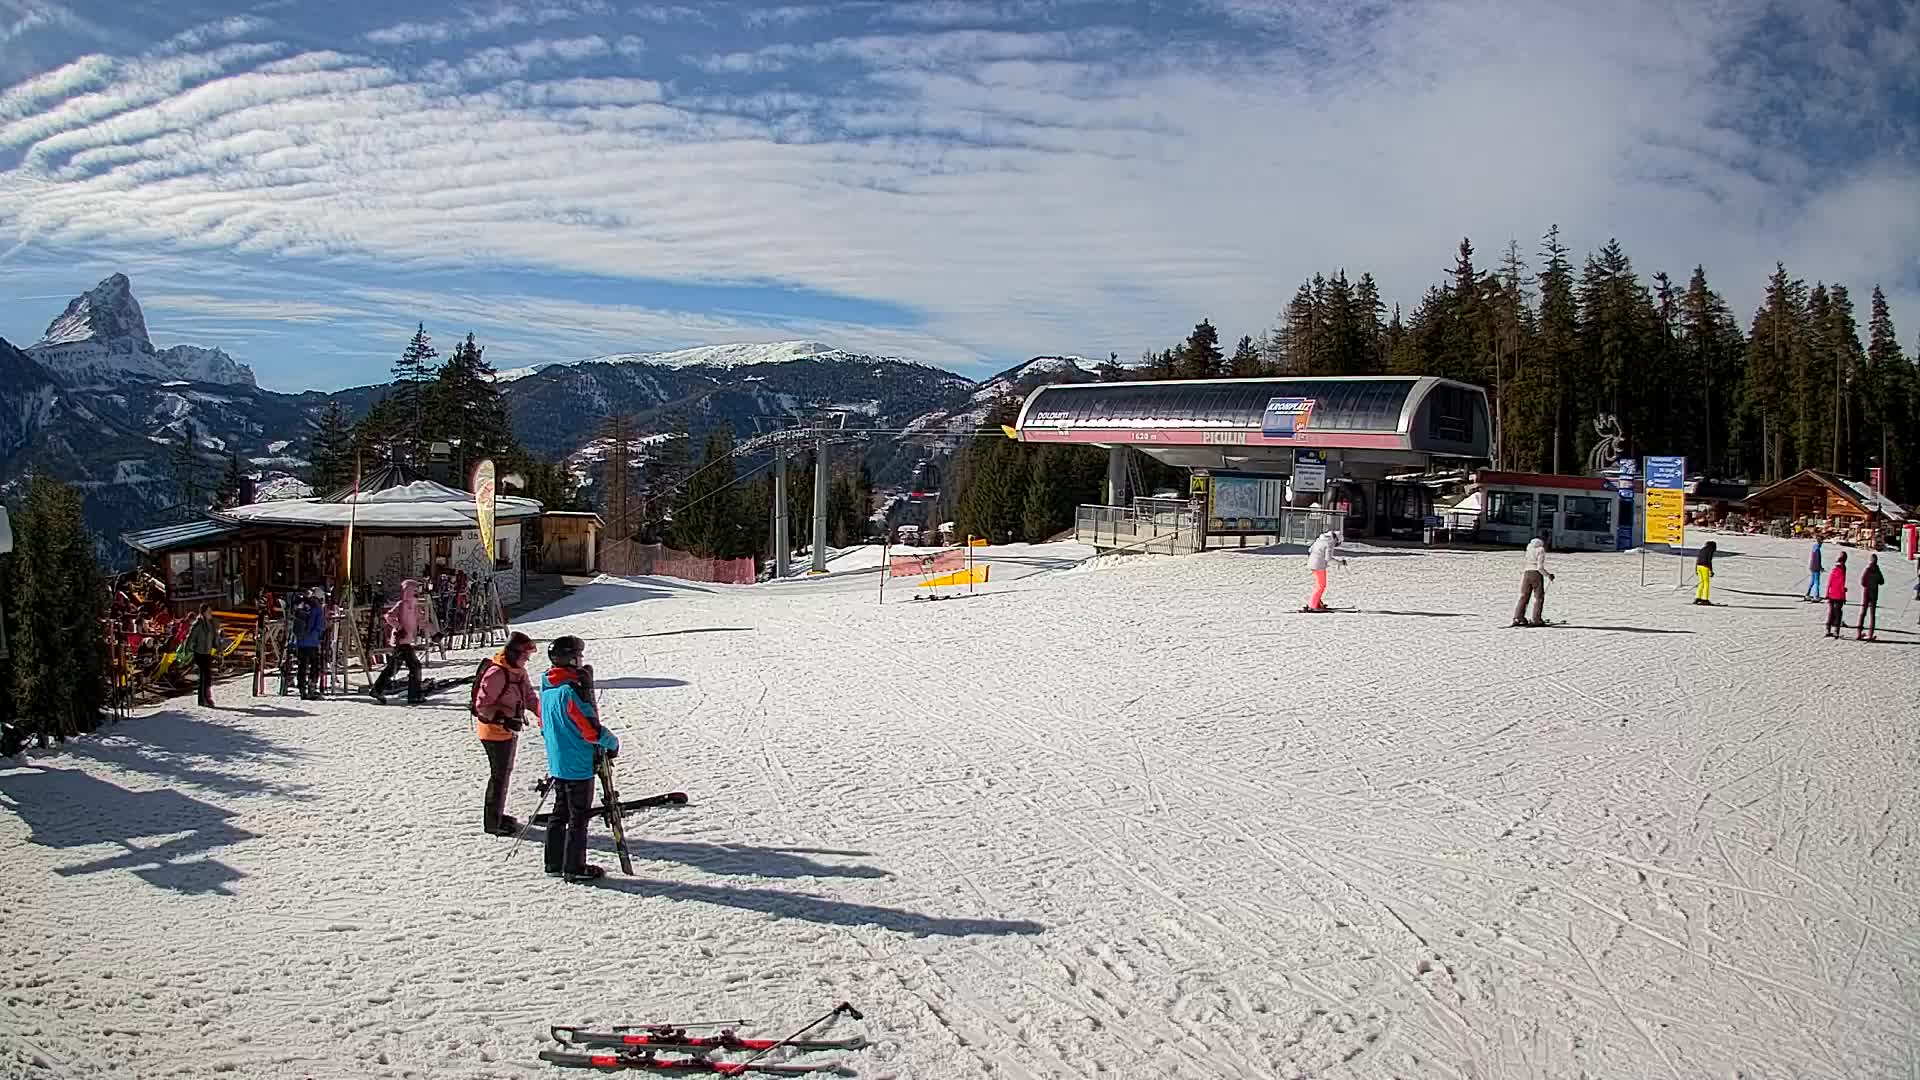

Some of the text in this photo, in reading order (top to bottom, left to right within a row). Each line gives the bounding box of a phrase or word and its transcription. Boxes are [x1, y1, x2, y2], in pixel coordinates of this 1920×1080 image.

[1268, 402, 1312, 411] KRONPLATZ
[1037, 411, 1070, 420] DOLOMITI
[1131, 432, 1149, 440] 1620
[1203, 431, 1246, 444] PICULIN
